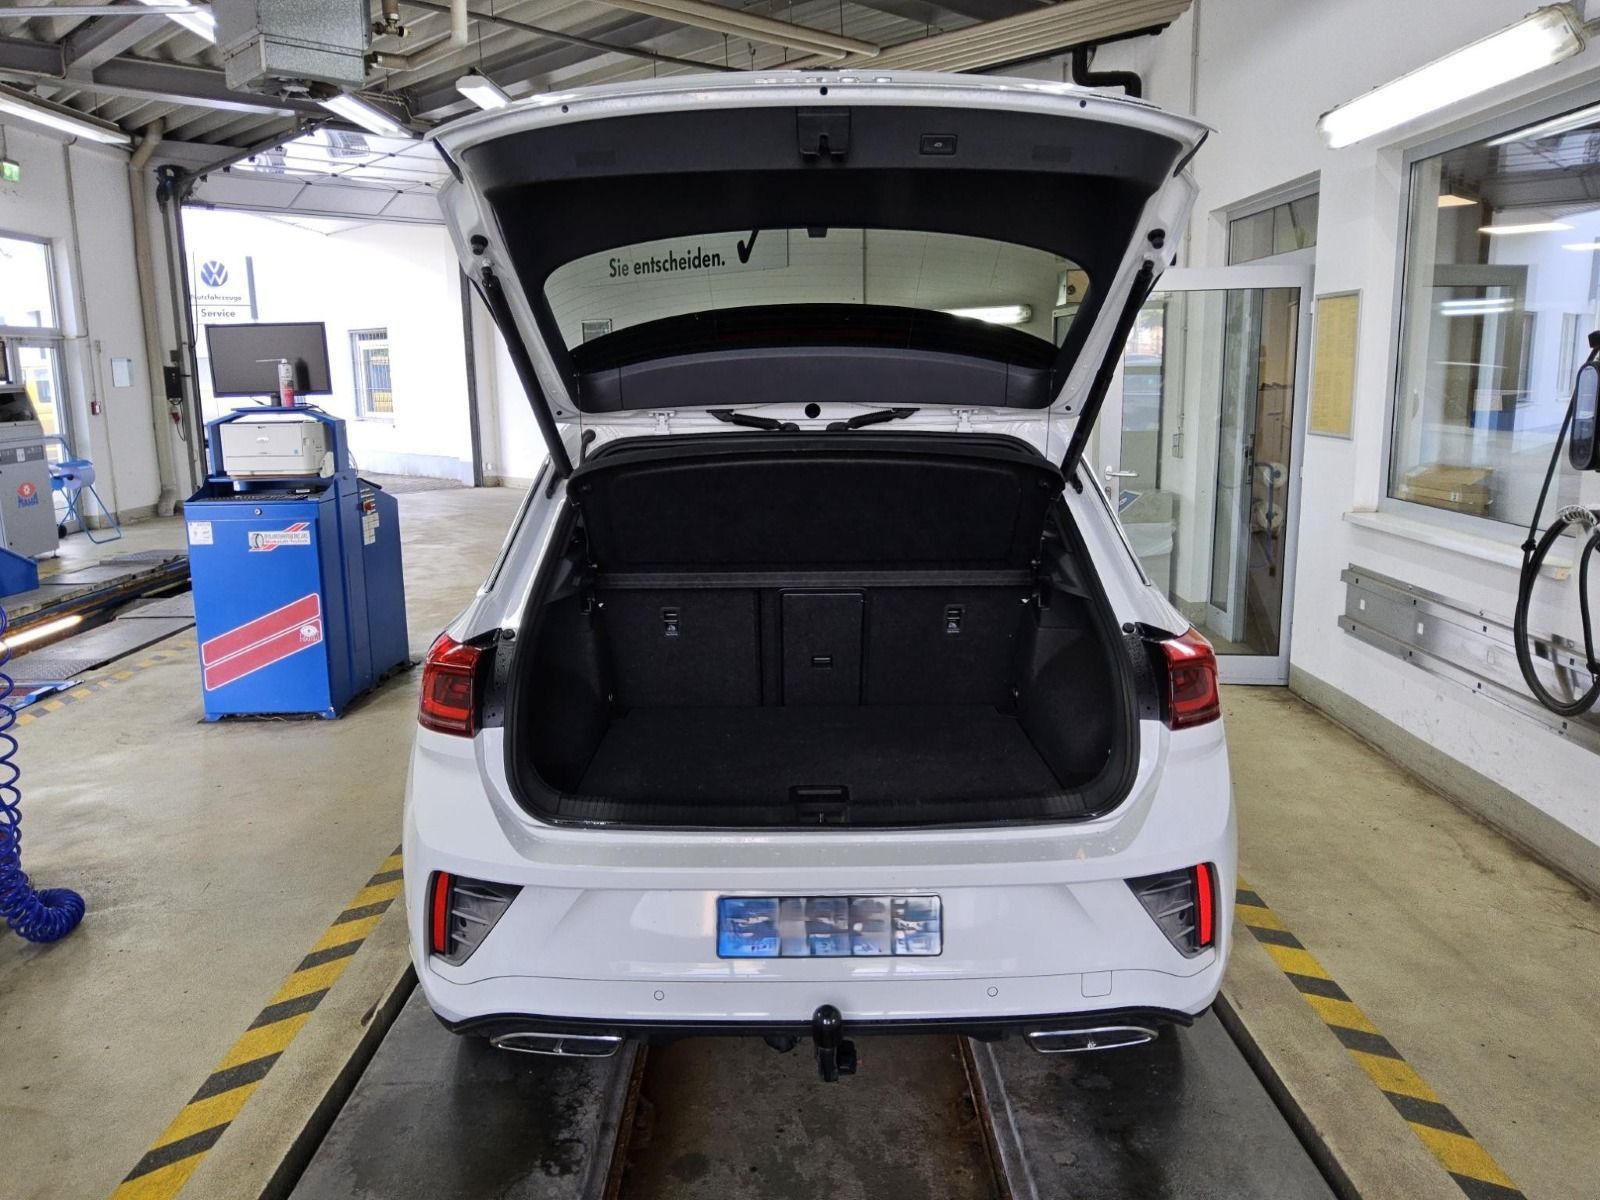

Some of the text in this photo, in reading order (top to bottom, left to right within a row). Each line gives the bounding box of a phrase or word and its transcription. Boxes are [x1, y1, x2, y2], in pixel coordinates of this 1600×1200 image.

[609, 246, 726, 278] Sie entscheiden.
[201, 308, 236, 318] Service
